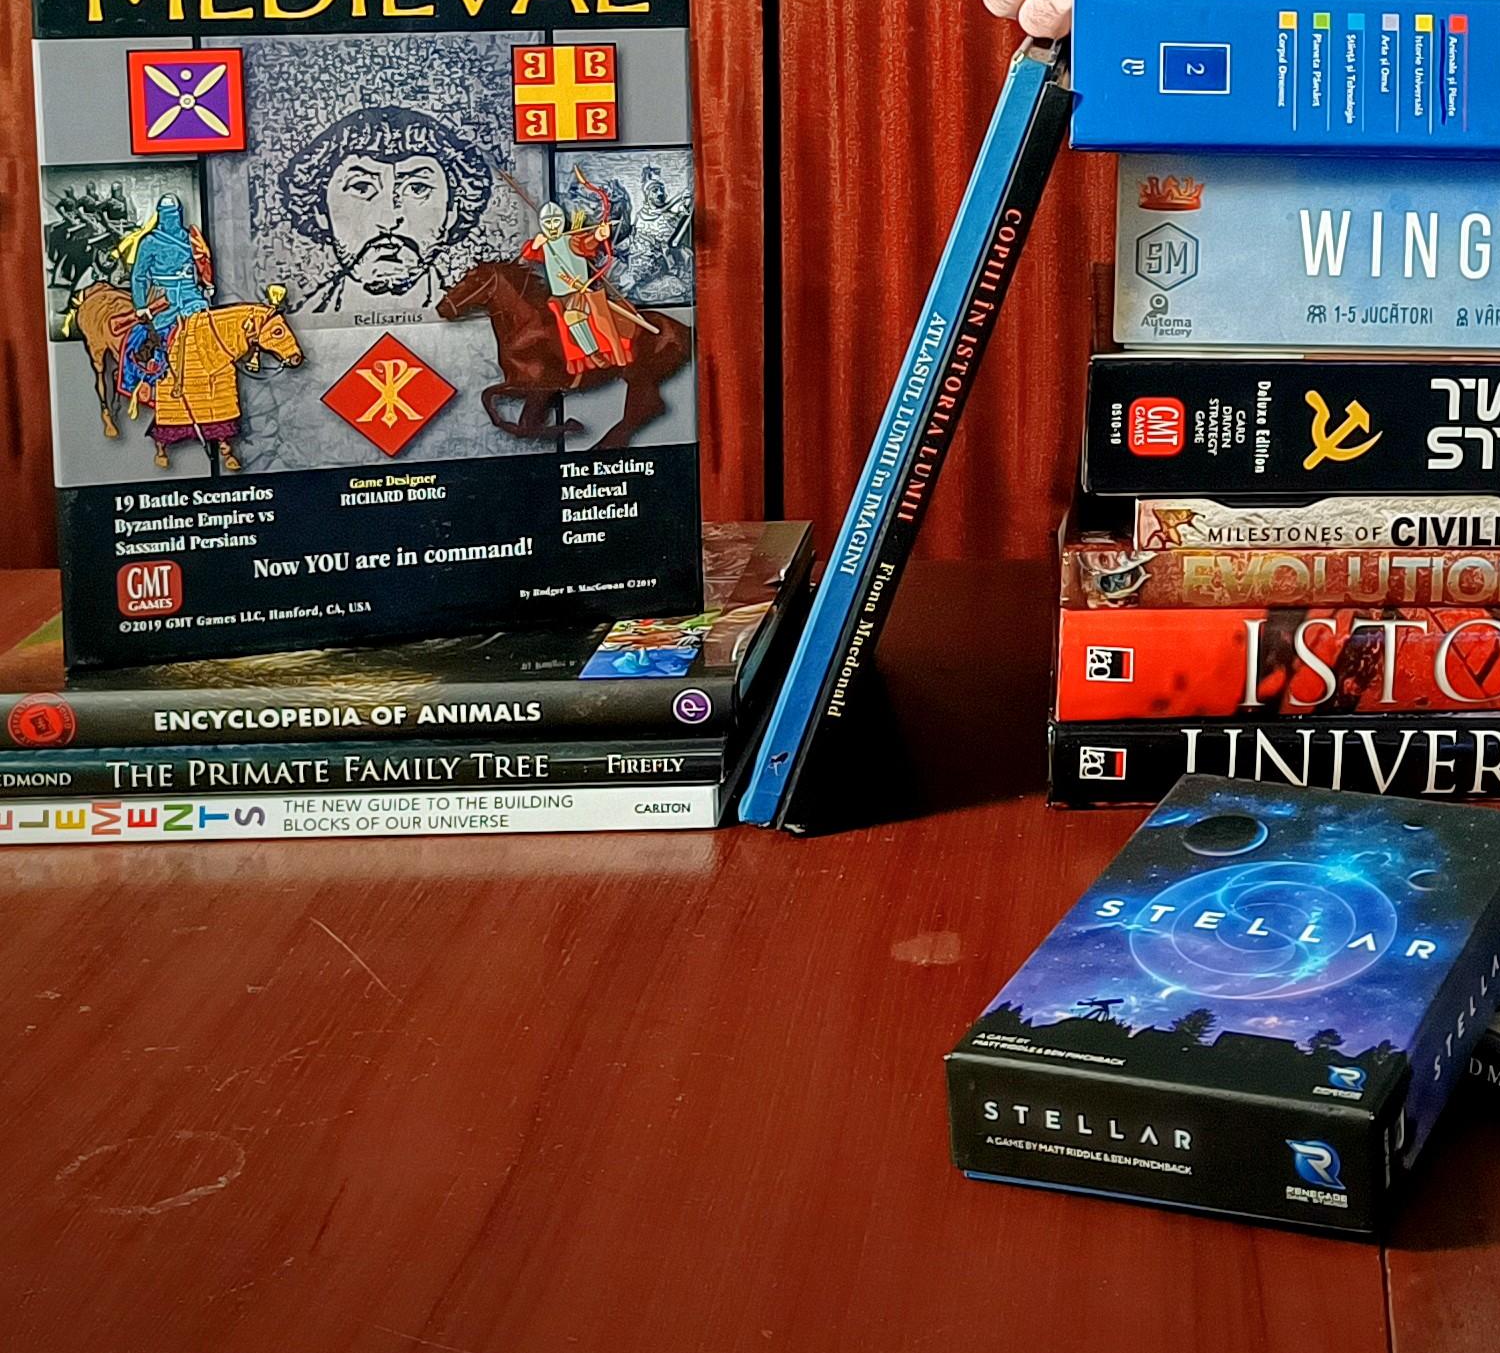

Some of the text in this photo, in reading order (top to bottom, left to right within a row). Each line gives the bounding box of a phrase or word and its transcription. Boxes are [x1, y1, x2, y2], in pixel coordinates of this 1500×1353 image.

[1186, 63, 1205, 76] 2
[354, 311, 423, 326] Belisarius
[1141, 316, 1192, 328] Automa
[1335, 302, 1433, 325] 1-5 JUCĂTORI
[1154, 327, 1192, 338] factory
[1134, 406, 1145, 446] GAMES
[1147, 406, 1179, 446] GMT
[1194, 410, 1205, 444] GAME
[1208, 398, 1219, 456] STRATEGY
[1222, 406, 1232, 448] DRIVEN
[1235, 410, 1246, 444] CARD
[1254, 381, 1272, 474] Deluxe Edition
[560, 458, 655, 478] The Exciting
[349, 472, 437, 489] Game Designer
[560, 482, 628, 500] Medieval
[115, 486, 274, 512] 19 Battle Scenarios
[340, 486, 447, 507] RICHARD BORG
[115, 509, 275, 537] Byzantine Empire vs
[561, 502, 639, 523] Battlefield
[115, 532, 257, 557] Sassanid Persians
[561, 530, 606, 545] Game
[1208, 526, 1343, 542] MILESTONES
[1355, 526, 1382, 541] OF
[253, 537, 534, 579] Now YOU are in command!
[126, 564, 172, 600] GMT
[128, 598, 173, 612] GAMES
[166, 616, 192, 629] GMT
[197, 613, 237, 626] Games
[240, 611, 266, 623] LLC,
[268, 604, 323, 621] Hanford,
[326, 602, 345, 616] CA,
[349, 601, 371, 613] USA
[827, 561, 895, 718] Fiona Macdonald
[154, 702, 542, 732] ENCYCLOPEDIA OF ANIMALS
[106, 752, 549, 789] THE PRIMATE FAMILY TREE
[605, 754, 686, 775] FIREFLY
[283, 794, 574, 814] THE NEW GUIDE TO THE BUILDING
[634, 802, 691, 814] CARLTON
[283, 815, 509, 832] BLOCKS OF OUR UNIVERSE
[986, 1135, 995, 1145] A
[995, 1137, 1024, 1149] GAME
[1026, 1142, 1038, 1150] BY
[1038, 1143, 1066, 1156] MATT
[1066, 1147, 1103, 1161] RIDDLE
[1110, 1154, 1132, 1166] BEN
[1132, 1157, 1193, 1175] PINCHBACK
